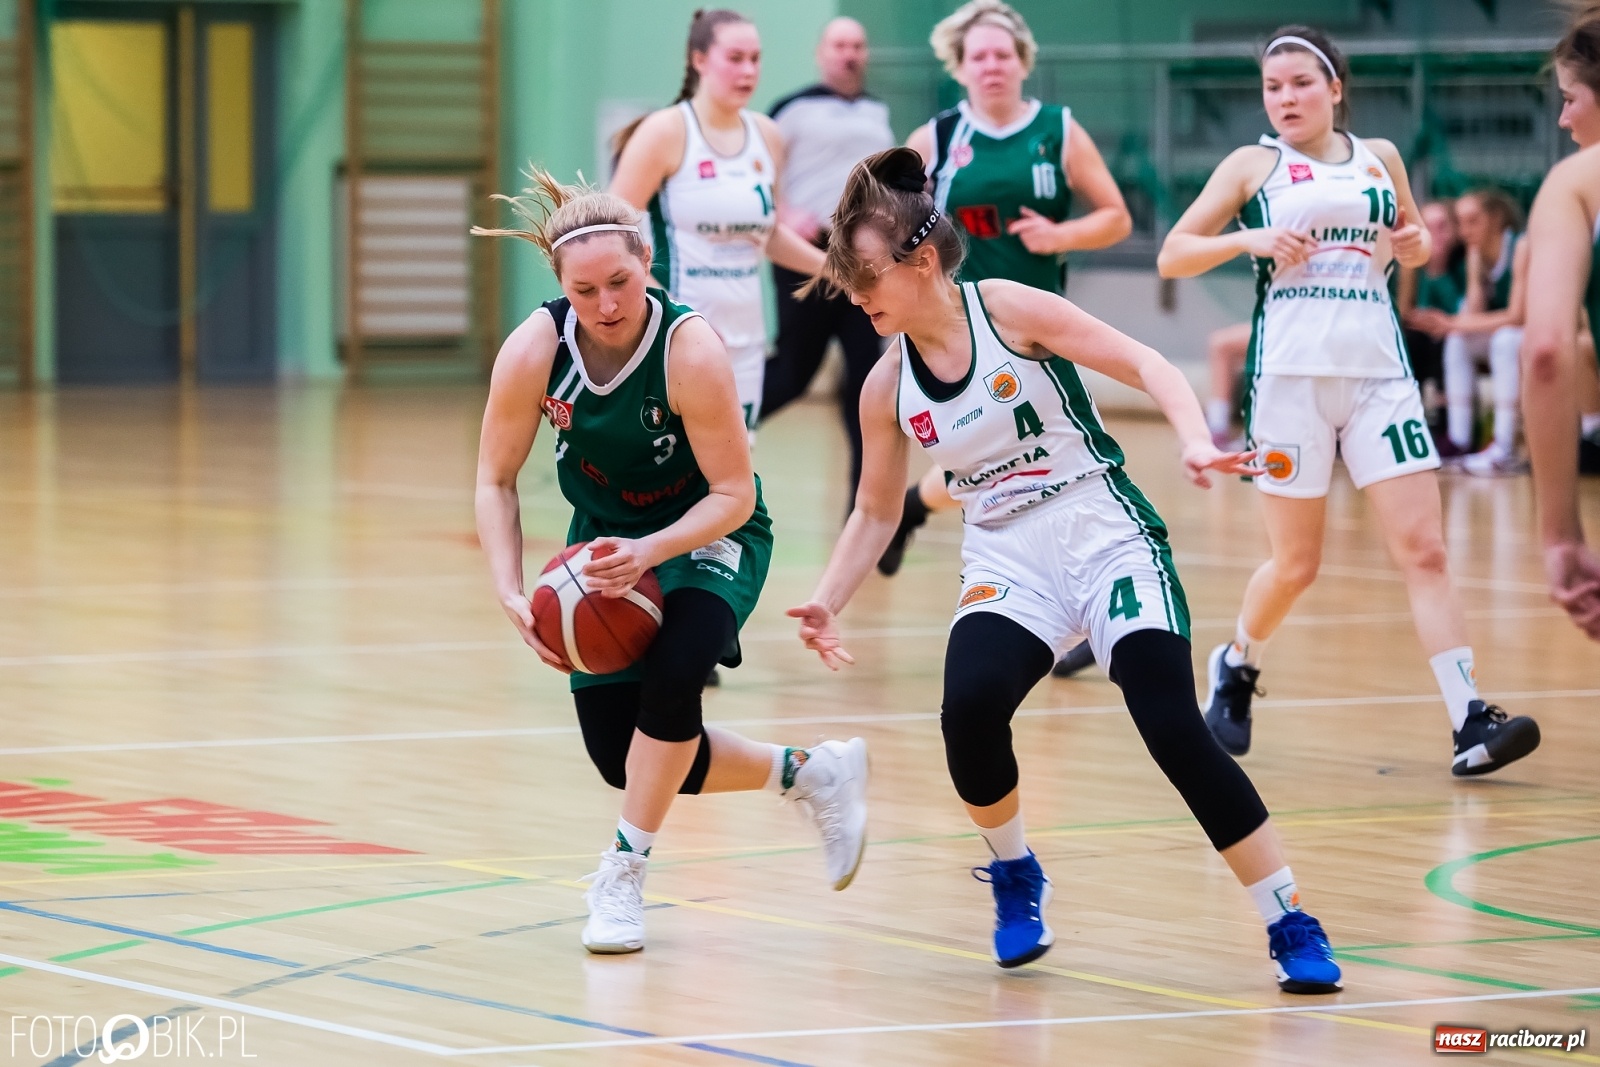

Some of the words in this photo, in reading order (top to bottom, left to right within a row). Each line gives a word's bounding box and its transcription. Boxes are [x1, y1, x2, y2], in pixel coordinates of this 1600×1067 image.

[1033, 162, 1056, 199] 10
[1361, 187, 1396, 228] 16
[1311, 227, 1378, 243] LIMPIA
[956, 406, 983, 430] PROTON
[1013, 401, 1045, 441] 4
[653, 433, 679, 466] 3
[1382, 419, 1429, 464] 16
[1108, 575, 1142, 621] 4
